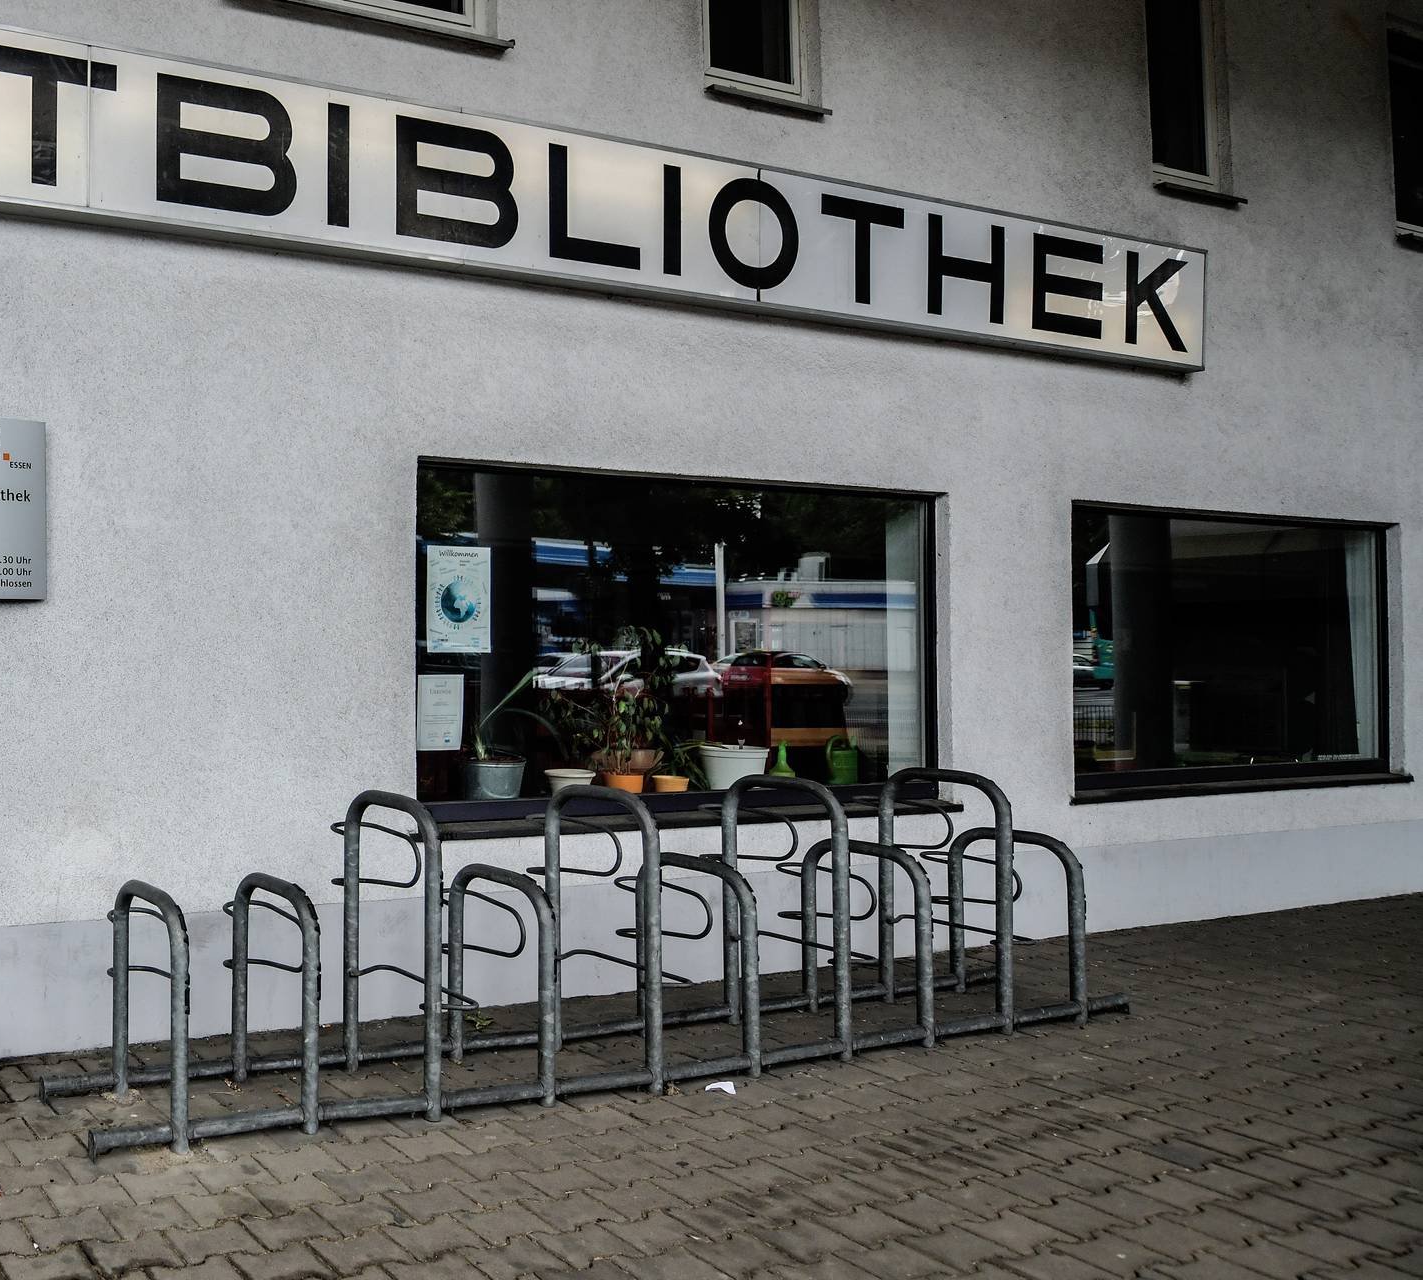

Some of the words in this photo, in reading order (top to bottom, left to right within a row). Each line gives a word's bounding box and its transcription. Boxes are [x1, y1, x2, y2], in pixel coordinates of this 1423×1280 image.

[9, 461, 32, 470] ESSEN
[438, 549, 479, 558] Willkommen
[15, 556, 32, 564] Uhr
[15, 568, 32, 576] Uhr
